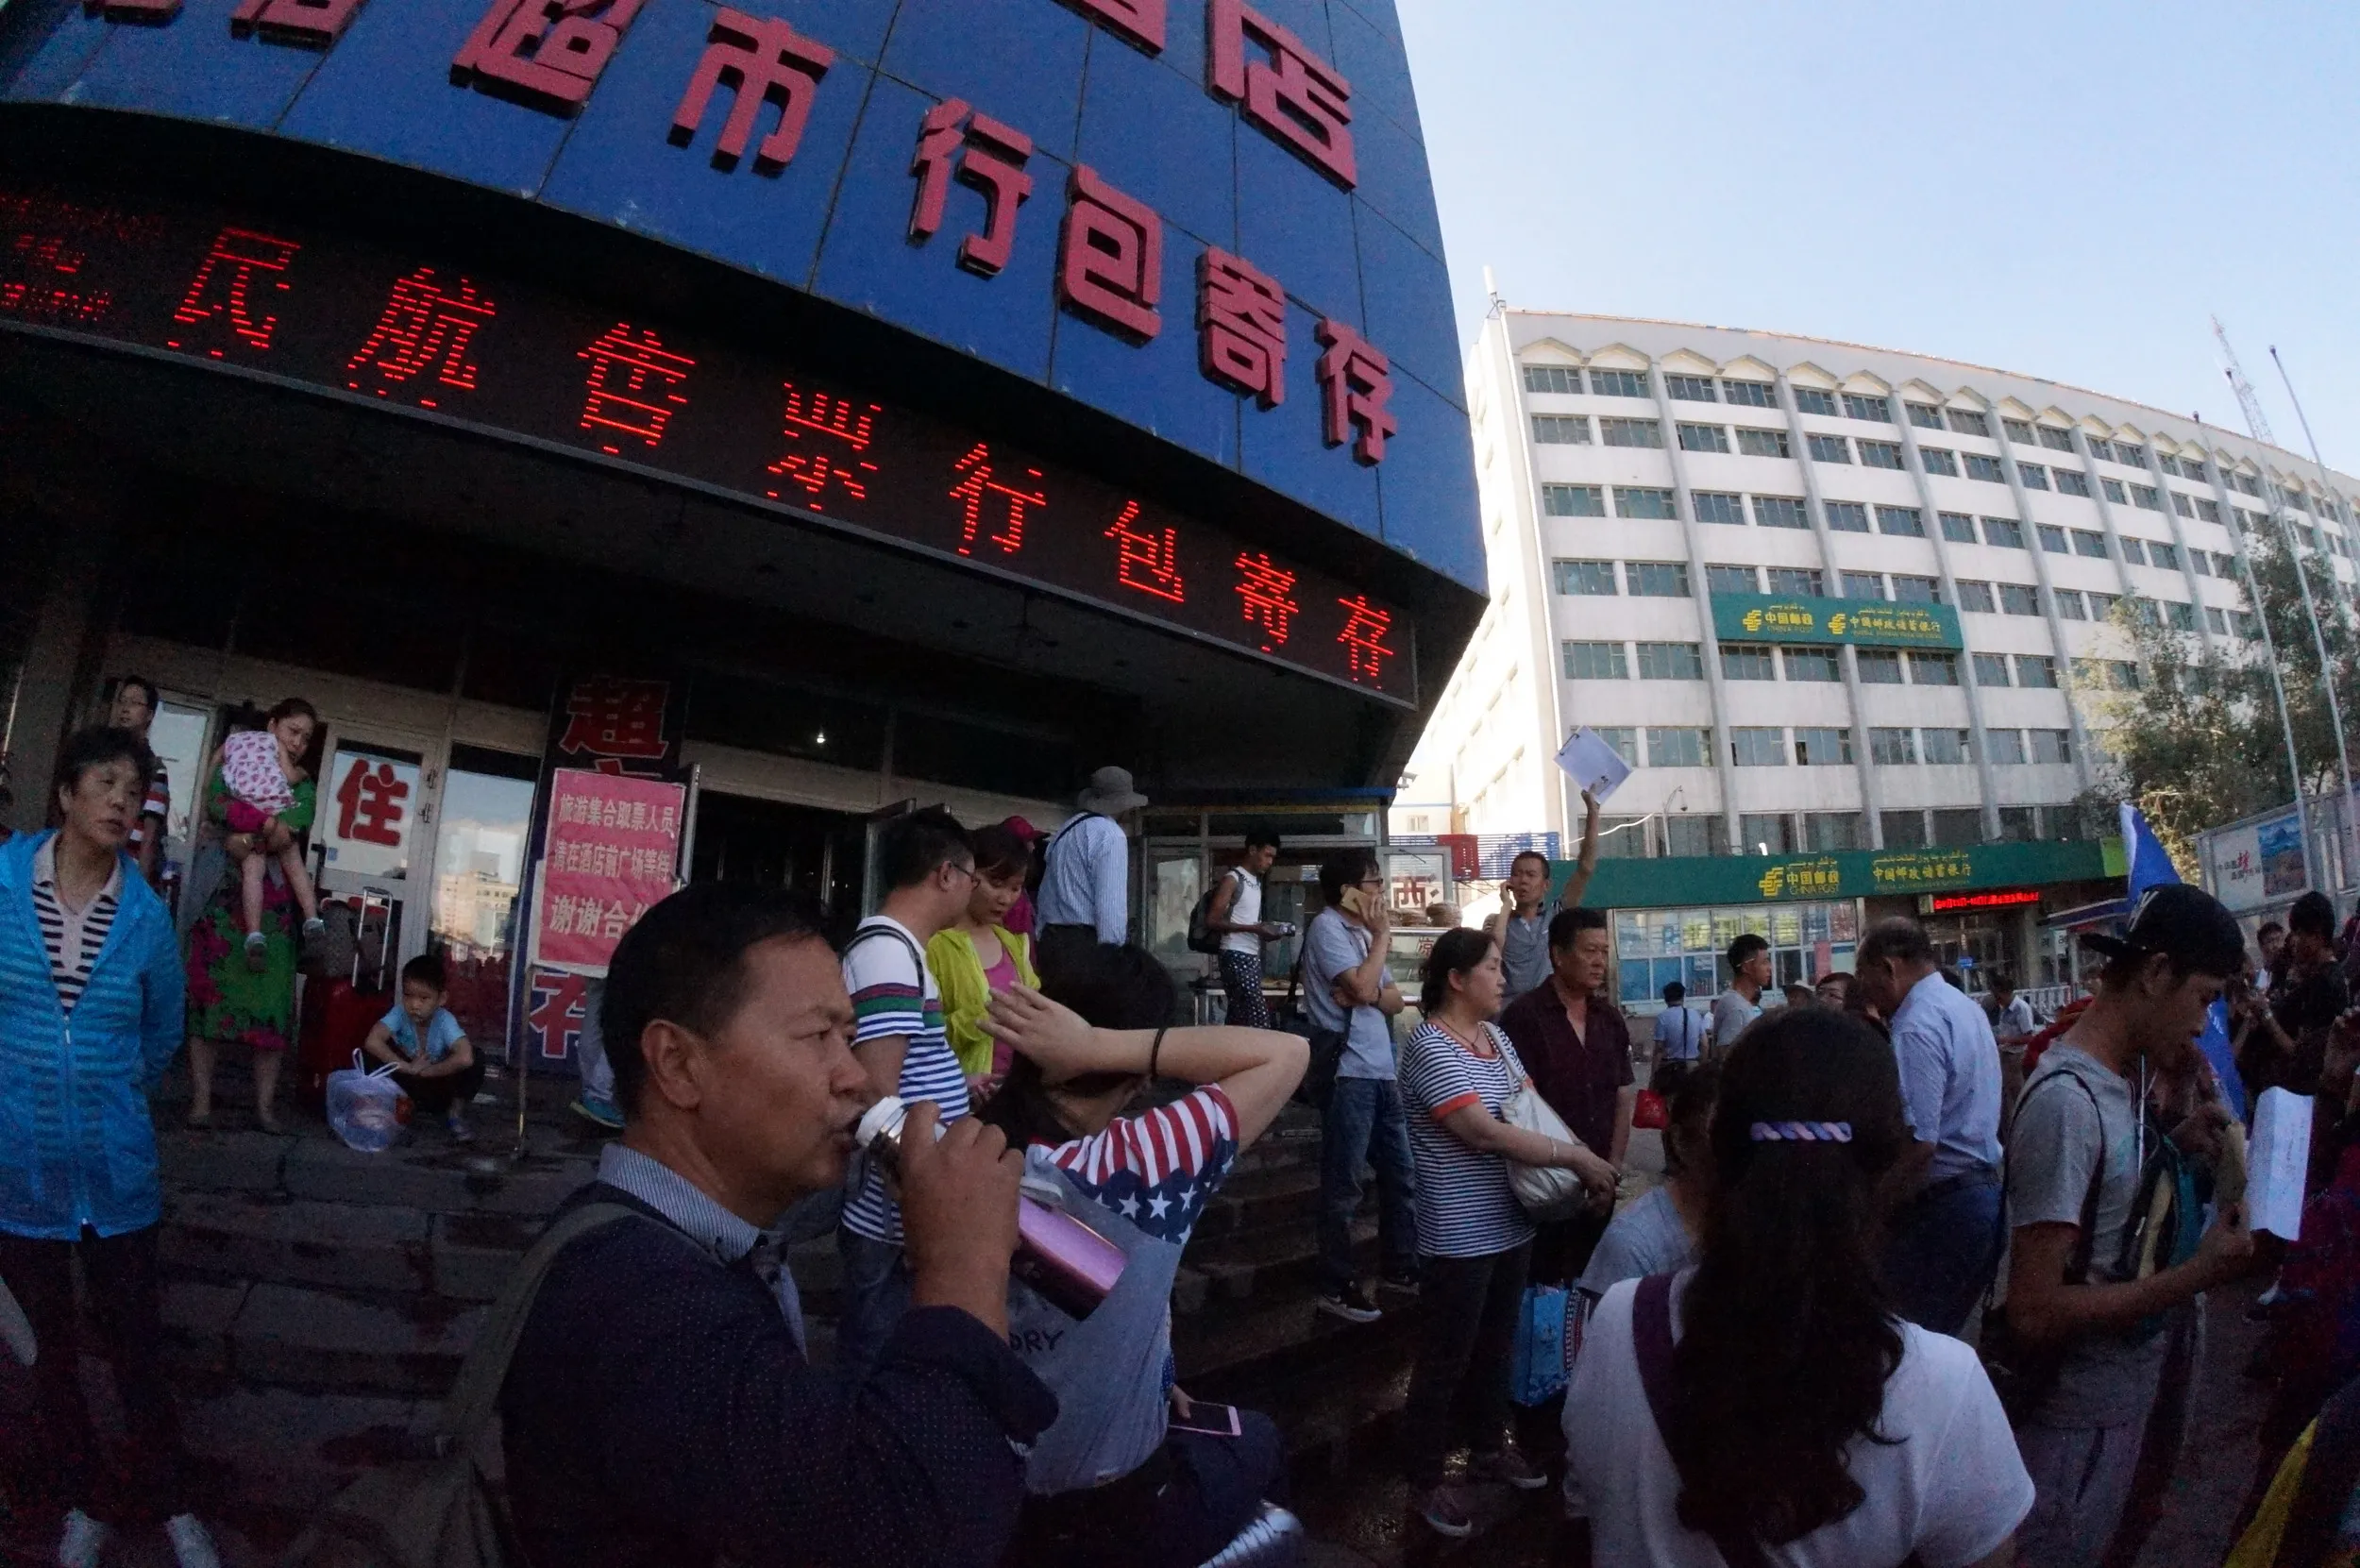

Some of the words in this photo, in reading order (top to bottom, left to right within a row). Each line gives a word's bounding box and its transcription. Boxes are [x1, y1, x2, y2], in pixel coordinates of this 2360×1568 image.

[83, 0, 1399, 466] 超市行包寄存
[1764, 612, 1813, 627] 中国邮政
[1849, 615, 1940, 632] 中国邮政储蓄银行
[336, 758, 410, 848] 住
[1787, 869, 1839, 886] 中国邮政
[1873, 863, 1971, 883] 中国邮政储蓄银行
[1789, 884, 1815, 895] CHINA
[1816, 883, 1840, 894] POST
